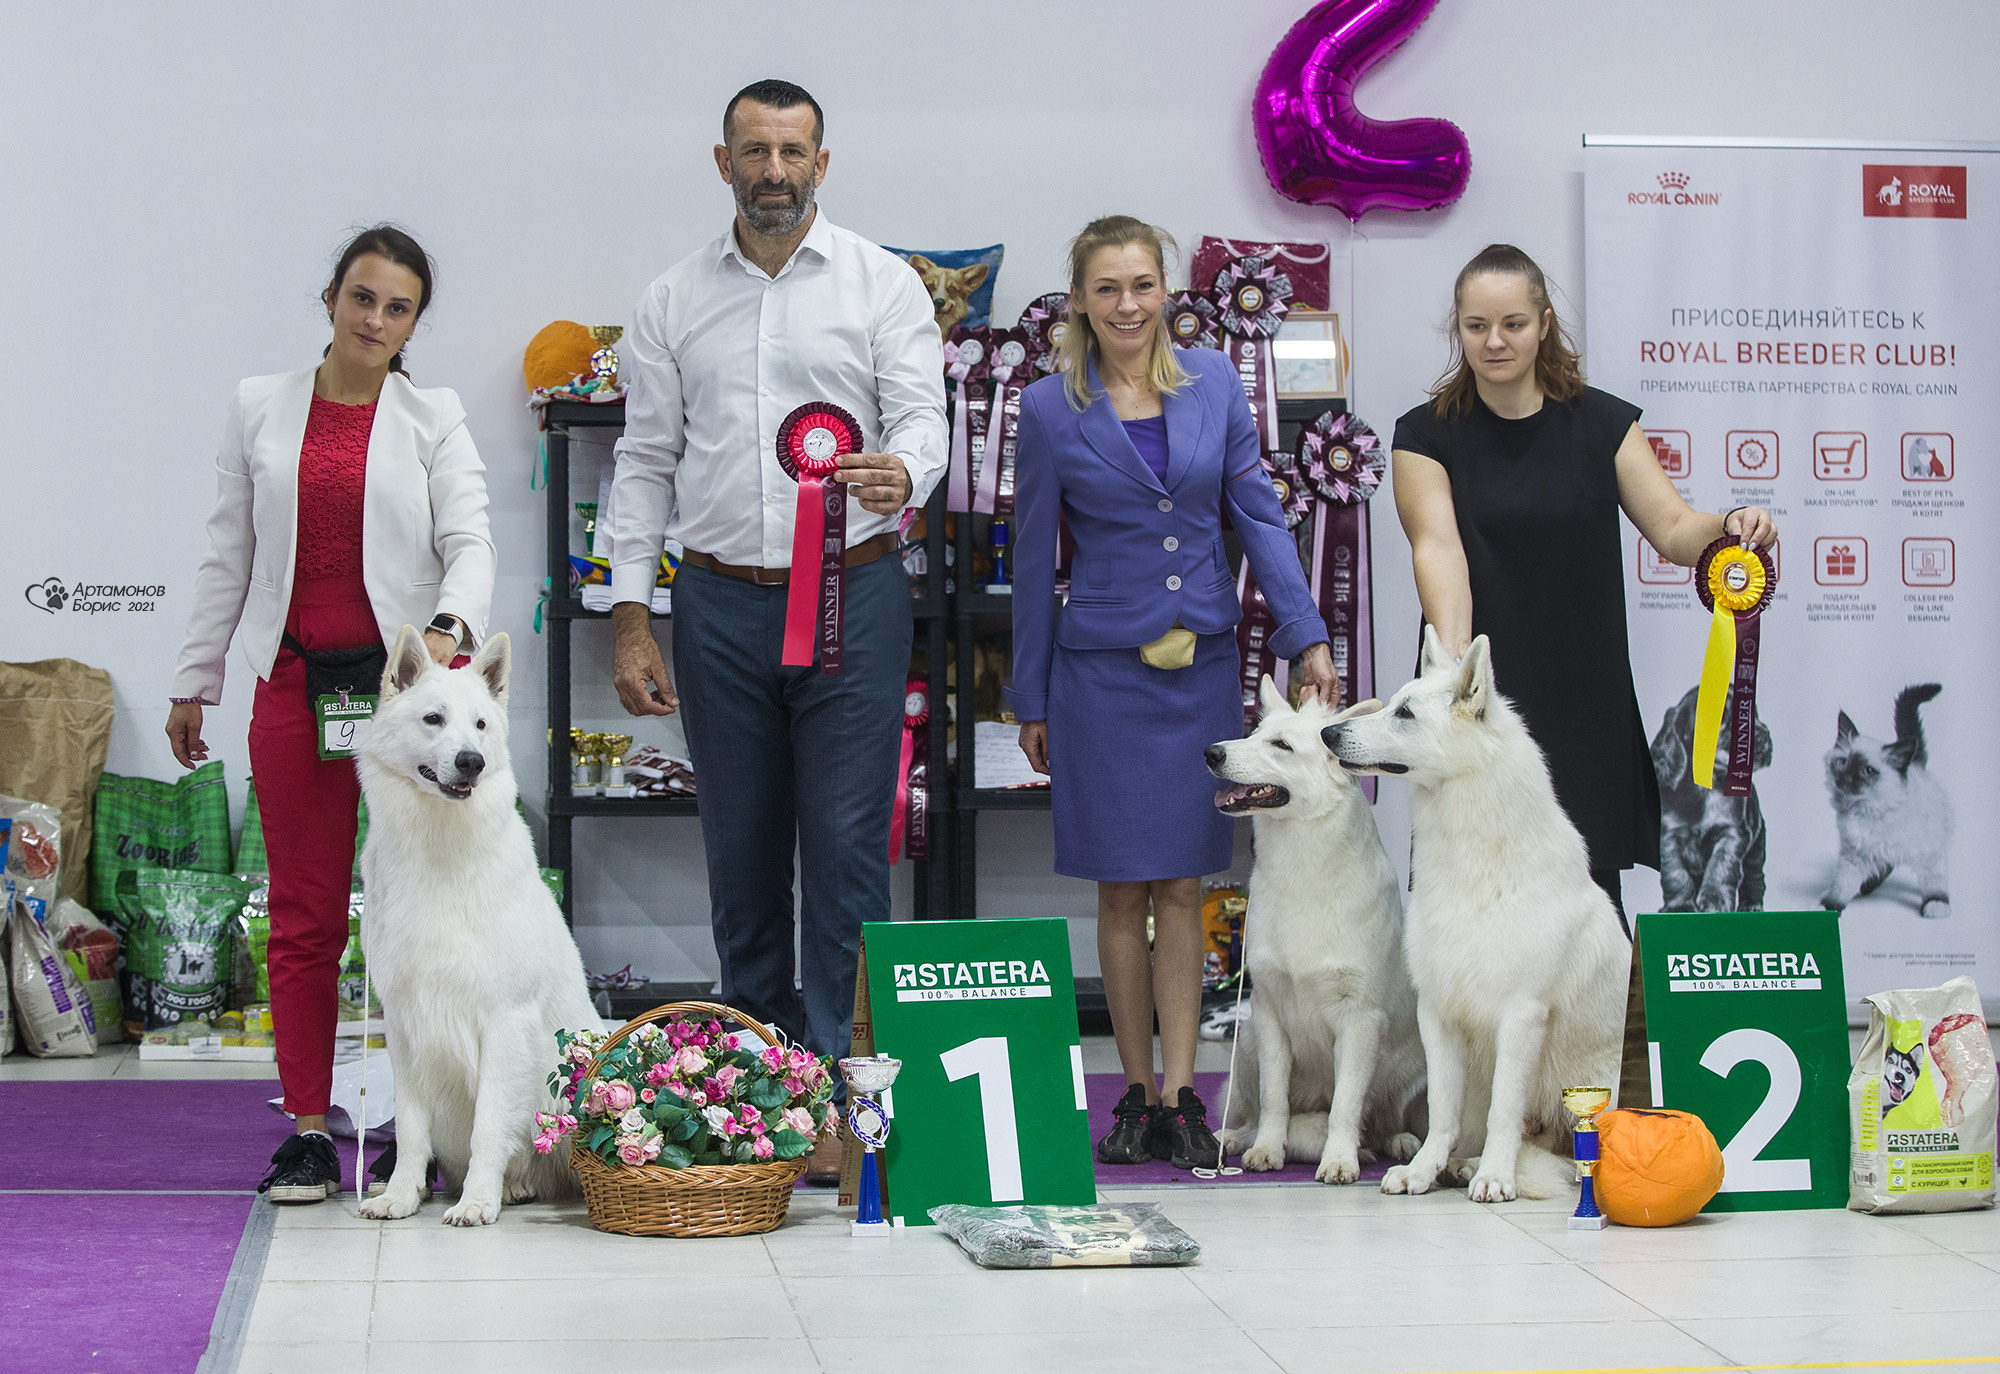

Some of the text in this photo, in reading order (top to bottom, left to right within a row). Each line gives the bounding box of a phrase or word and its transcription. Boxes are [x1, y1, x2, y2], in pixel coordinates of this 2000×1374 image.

[1908, 184, 1955, 197] ROYAL
[1628, 193, 1671, 205] ROYAL
[1671, 306, 1925, 331] ПРИСОЕДИНЯЙТЕСЬ К
[1640, 341, 1957, 366] ROYAL BREEDER CLUB!
[1640, 380, 1755, 395] ПРЕИМУЩЕСТВА
[1758, 380, 1855, 395] ПАРТНЕРСТВА
[1872, 382, 1912, 395] ROYAL
[1916, 383, 1958, 396] CANIN
[1731, 487, 1775, 496] ВЫГОДНЫЕ
[1824, 489, 1856, 497] ON-LINE
[1892, 500, 1964, 509] ПРОДАЖИ ЩЕНКОВ
[1641, 592, 1689, 600] ПРОГРАММА
[1822, 594, 1860, 602] ПОДАРКИ
[1904, 594, 1954, 602] COLLEGE PRO
[824, 575, 838, 642] WINNER
[1639, 602, 1691, 610] ЛОЯЛЬНОСТИ
[1806, 604, 1877, 612] ДЛЯ ВЛАДЕЛЬЦЕВ
[1808, 614, 1842, 623] ЩЕНКОВ
[1851, 614, 1875, 622] КОТЯТ
[1243, 625, 1265, 706] WINNER
[336, 720, 356, 748] 9
[1736, 699, 1750, 766] WINNER
[911, 786, 925, 838] WINNER
[1691, 953, 1821, 977] STATERA
[918, 959, 1050, 987] STATERA
[1692, 980, 1797, 990] 100% BALANCE
[166, 993, 212, 1005] DOG FOOD
[919, 988, 1027, 1000] 100% BALANCE
[1699, 1028, 1812, 1193] 2
[939, 1036, 1024, 1202] 1
[1899, 1133, 1959, 1145] STATERA
[1917, 1179, 1949, 1188] КУРИЦЕЙ
